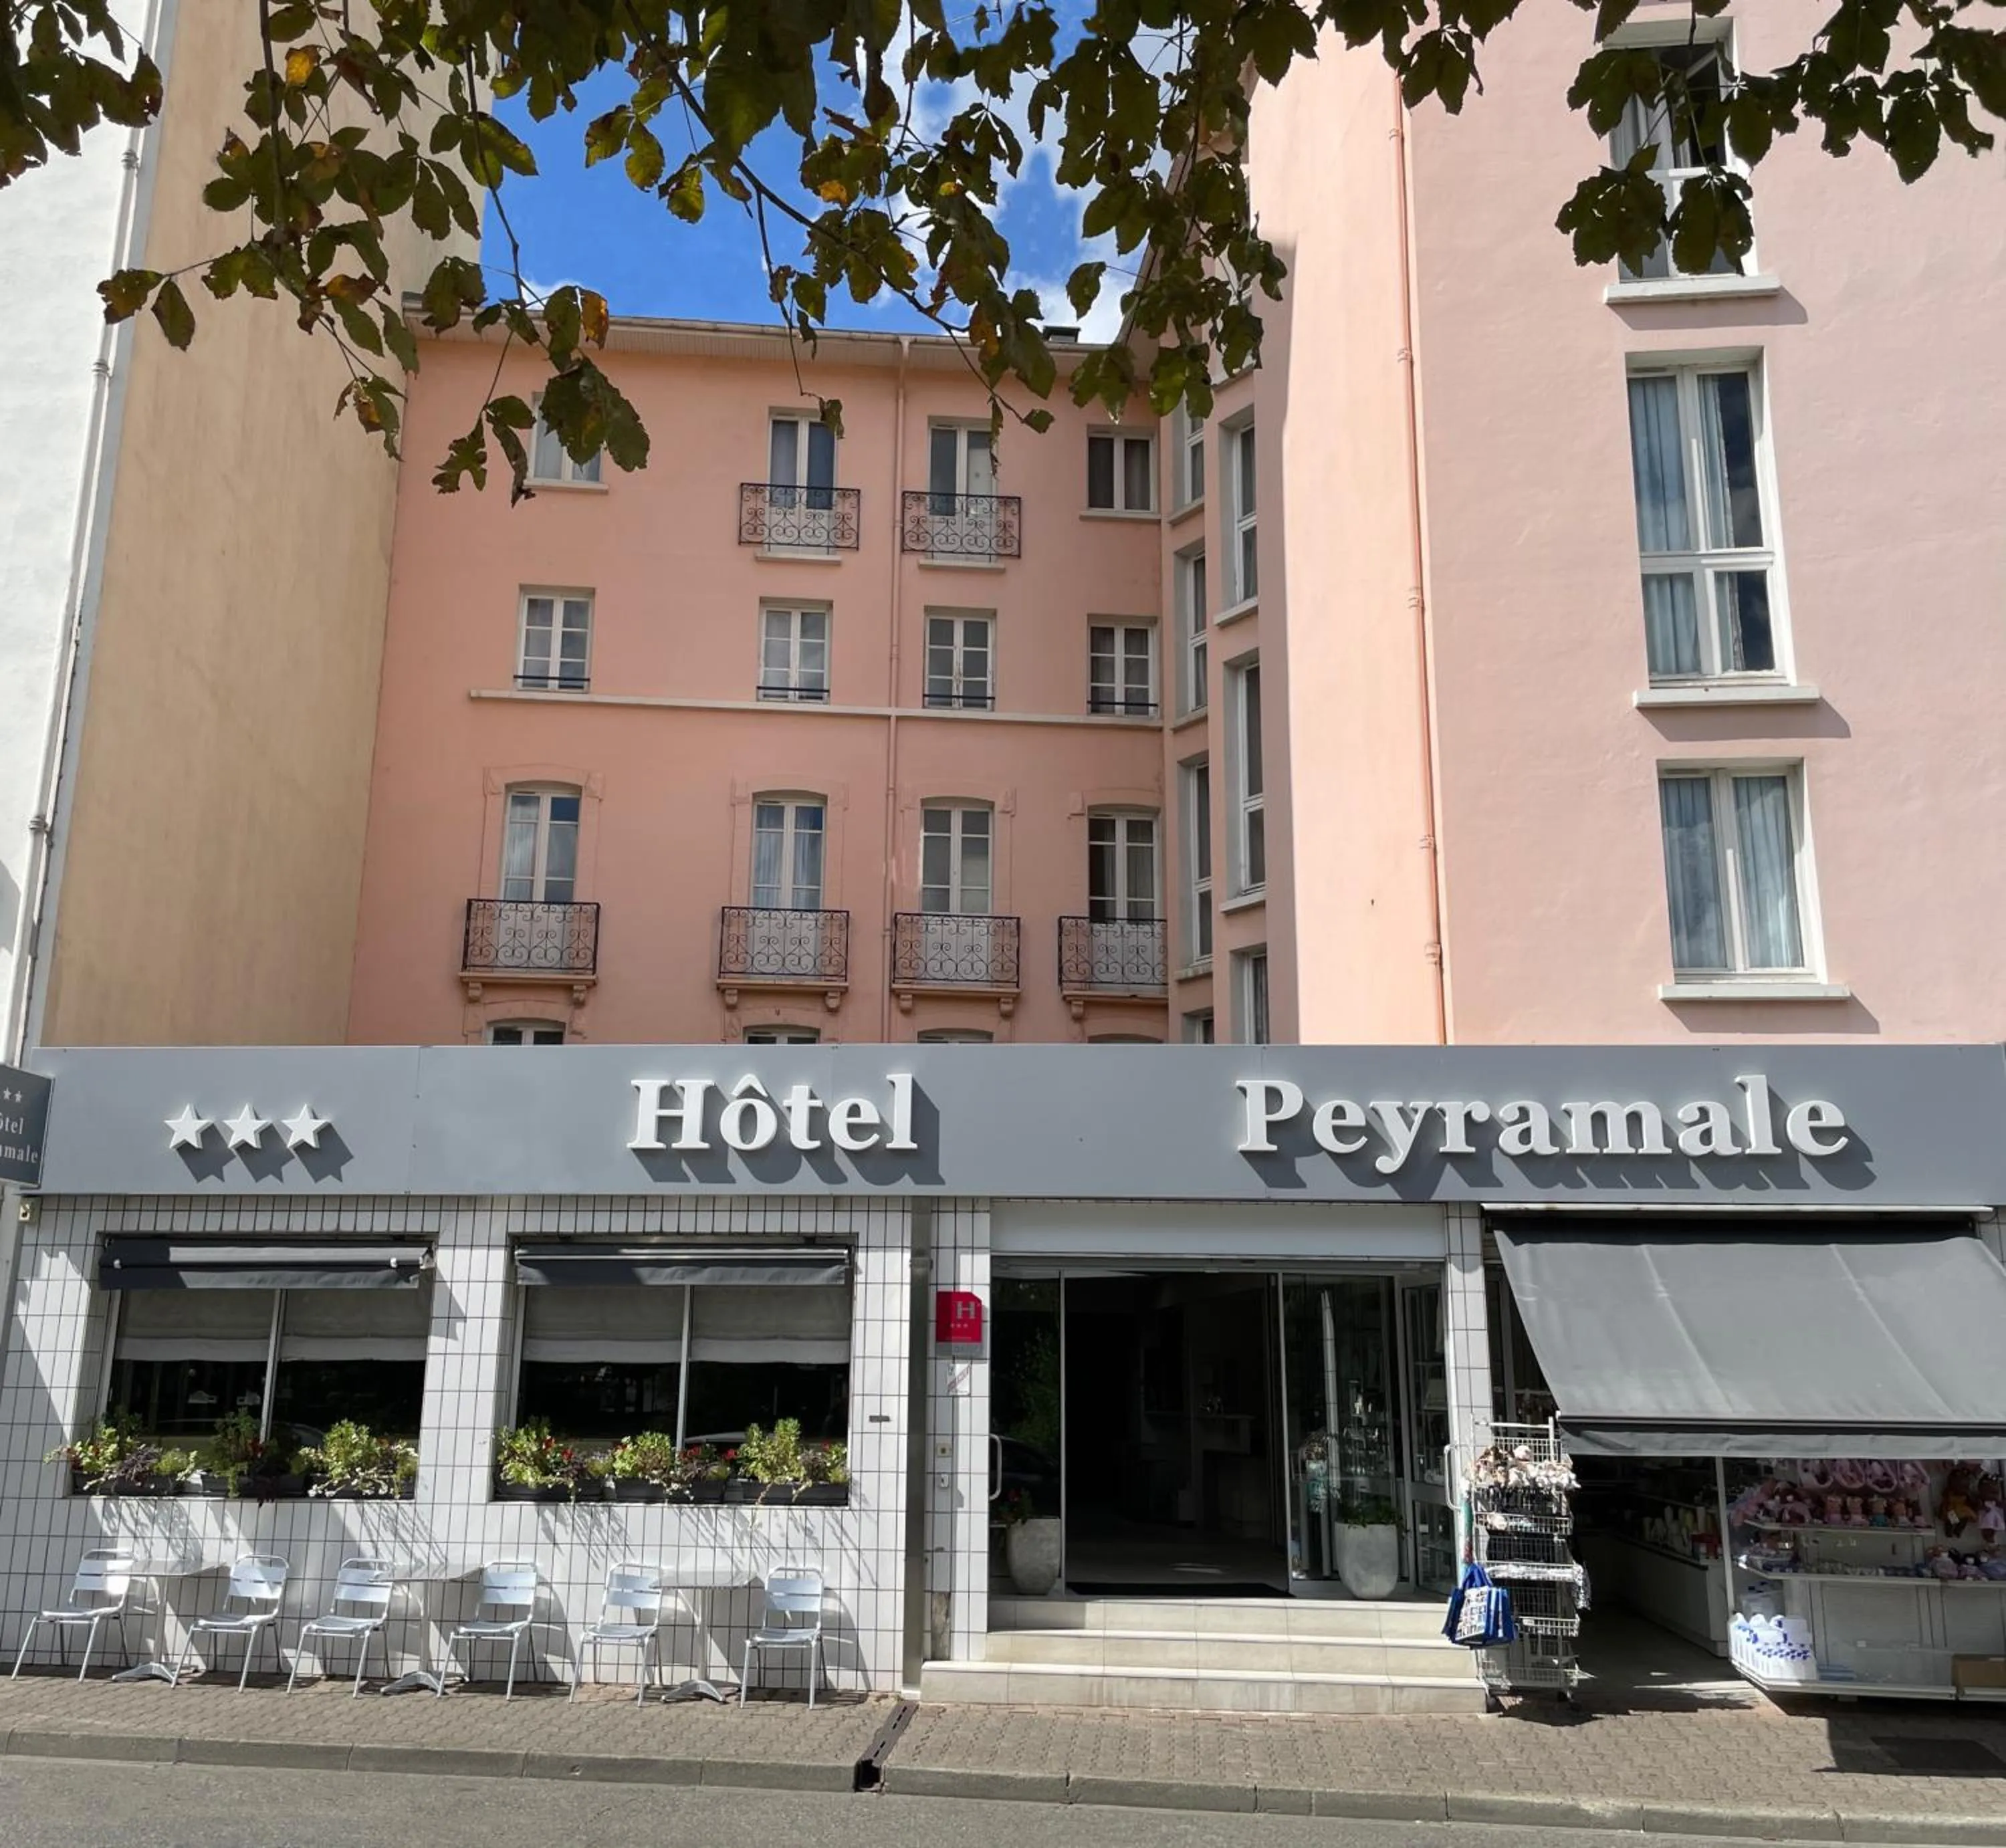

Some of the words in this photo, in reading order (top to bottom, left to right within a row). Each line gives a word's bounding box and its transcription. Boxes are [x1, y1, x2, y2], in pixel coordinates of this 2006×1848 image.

[627, 1074, 917, 1151] Hôtel
[1236, 1074, 1848, 1174] Peyramale
[957, 1300, 976, 1319] H
